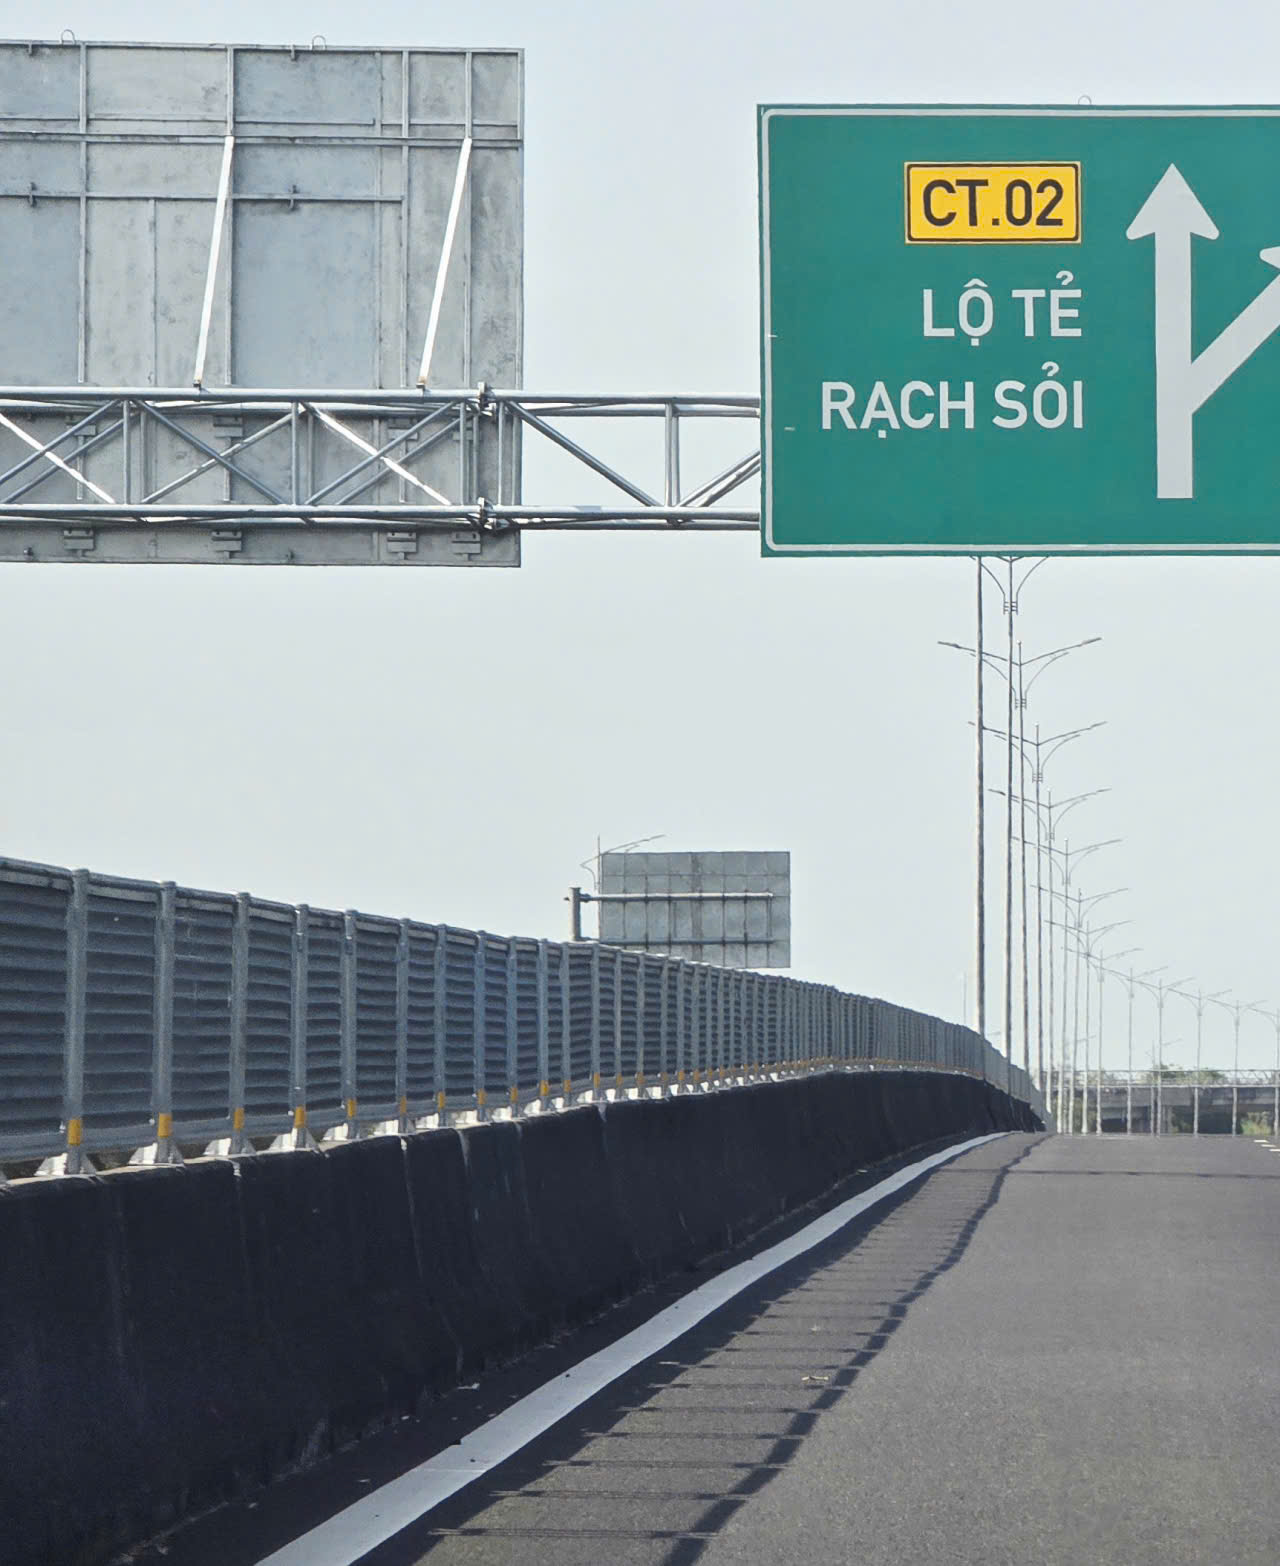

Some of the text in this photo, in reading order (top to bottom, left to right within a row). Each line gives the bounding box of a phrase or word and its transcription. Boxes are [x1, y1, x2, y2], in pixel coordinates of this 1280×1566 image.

[923, 178, 1064, 227] CT.02
[922, 270, 1083, 347] LỘ TẺ
[821, 361, 1084, 439] RẠCH SỎI
